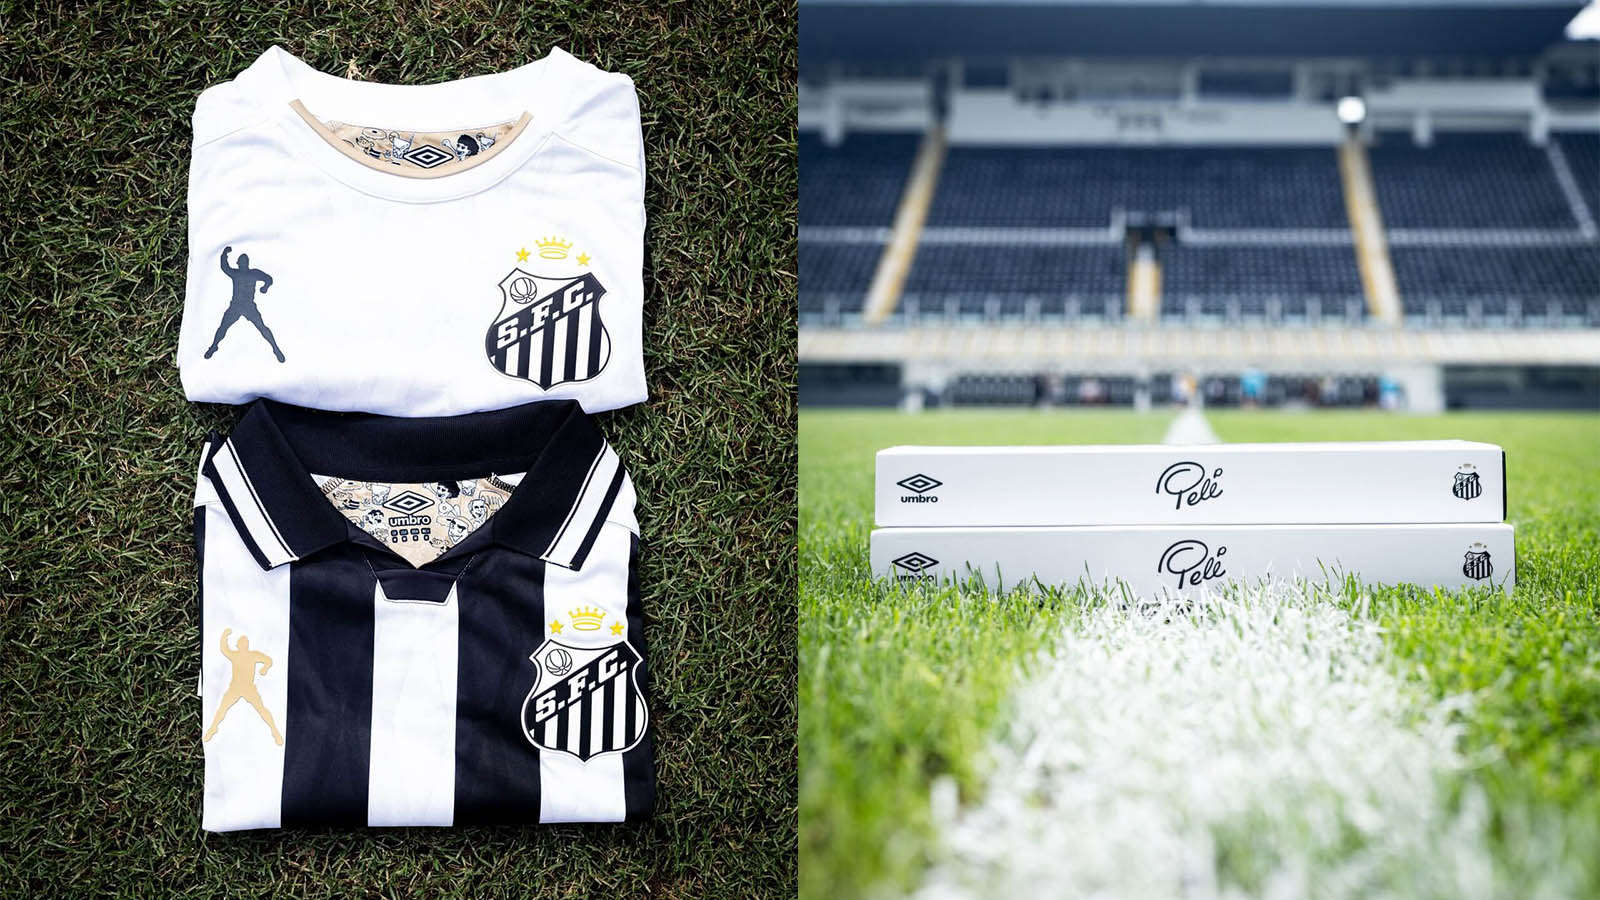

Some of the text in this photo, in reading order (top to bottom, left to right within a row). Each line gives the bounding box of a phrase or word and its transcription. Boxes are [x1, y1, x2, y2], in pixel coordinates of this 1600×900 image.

[497, 281, 593, 349] S.F.C.
[900, 494, 939, 503] umbro
[389, 515, 431, 527] umbro
[535, 650, 627, 723] S.F.C.
